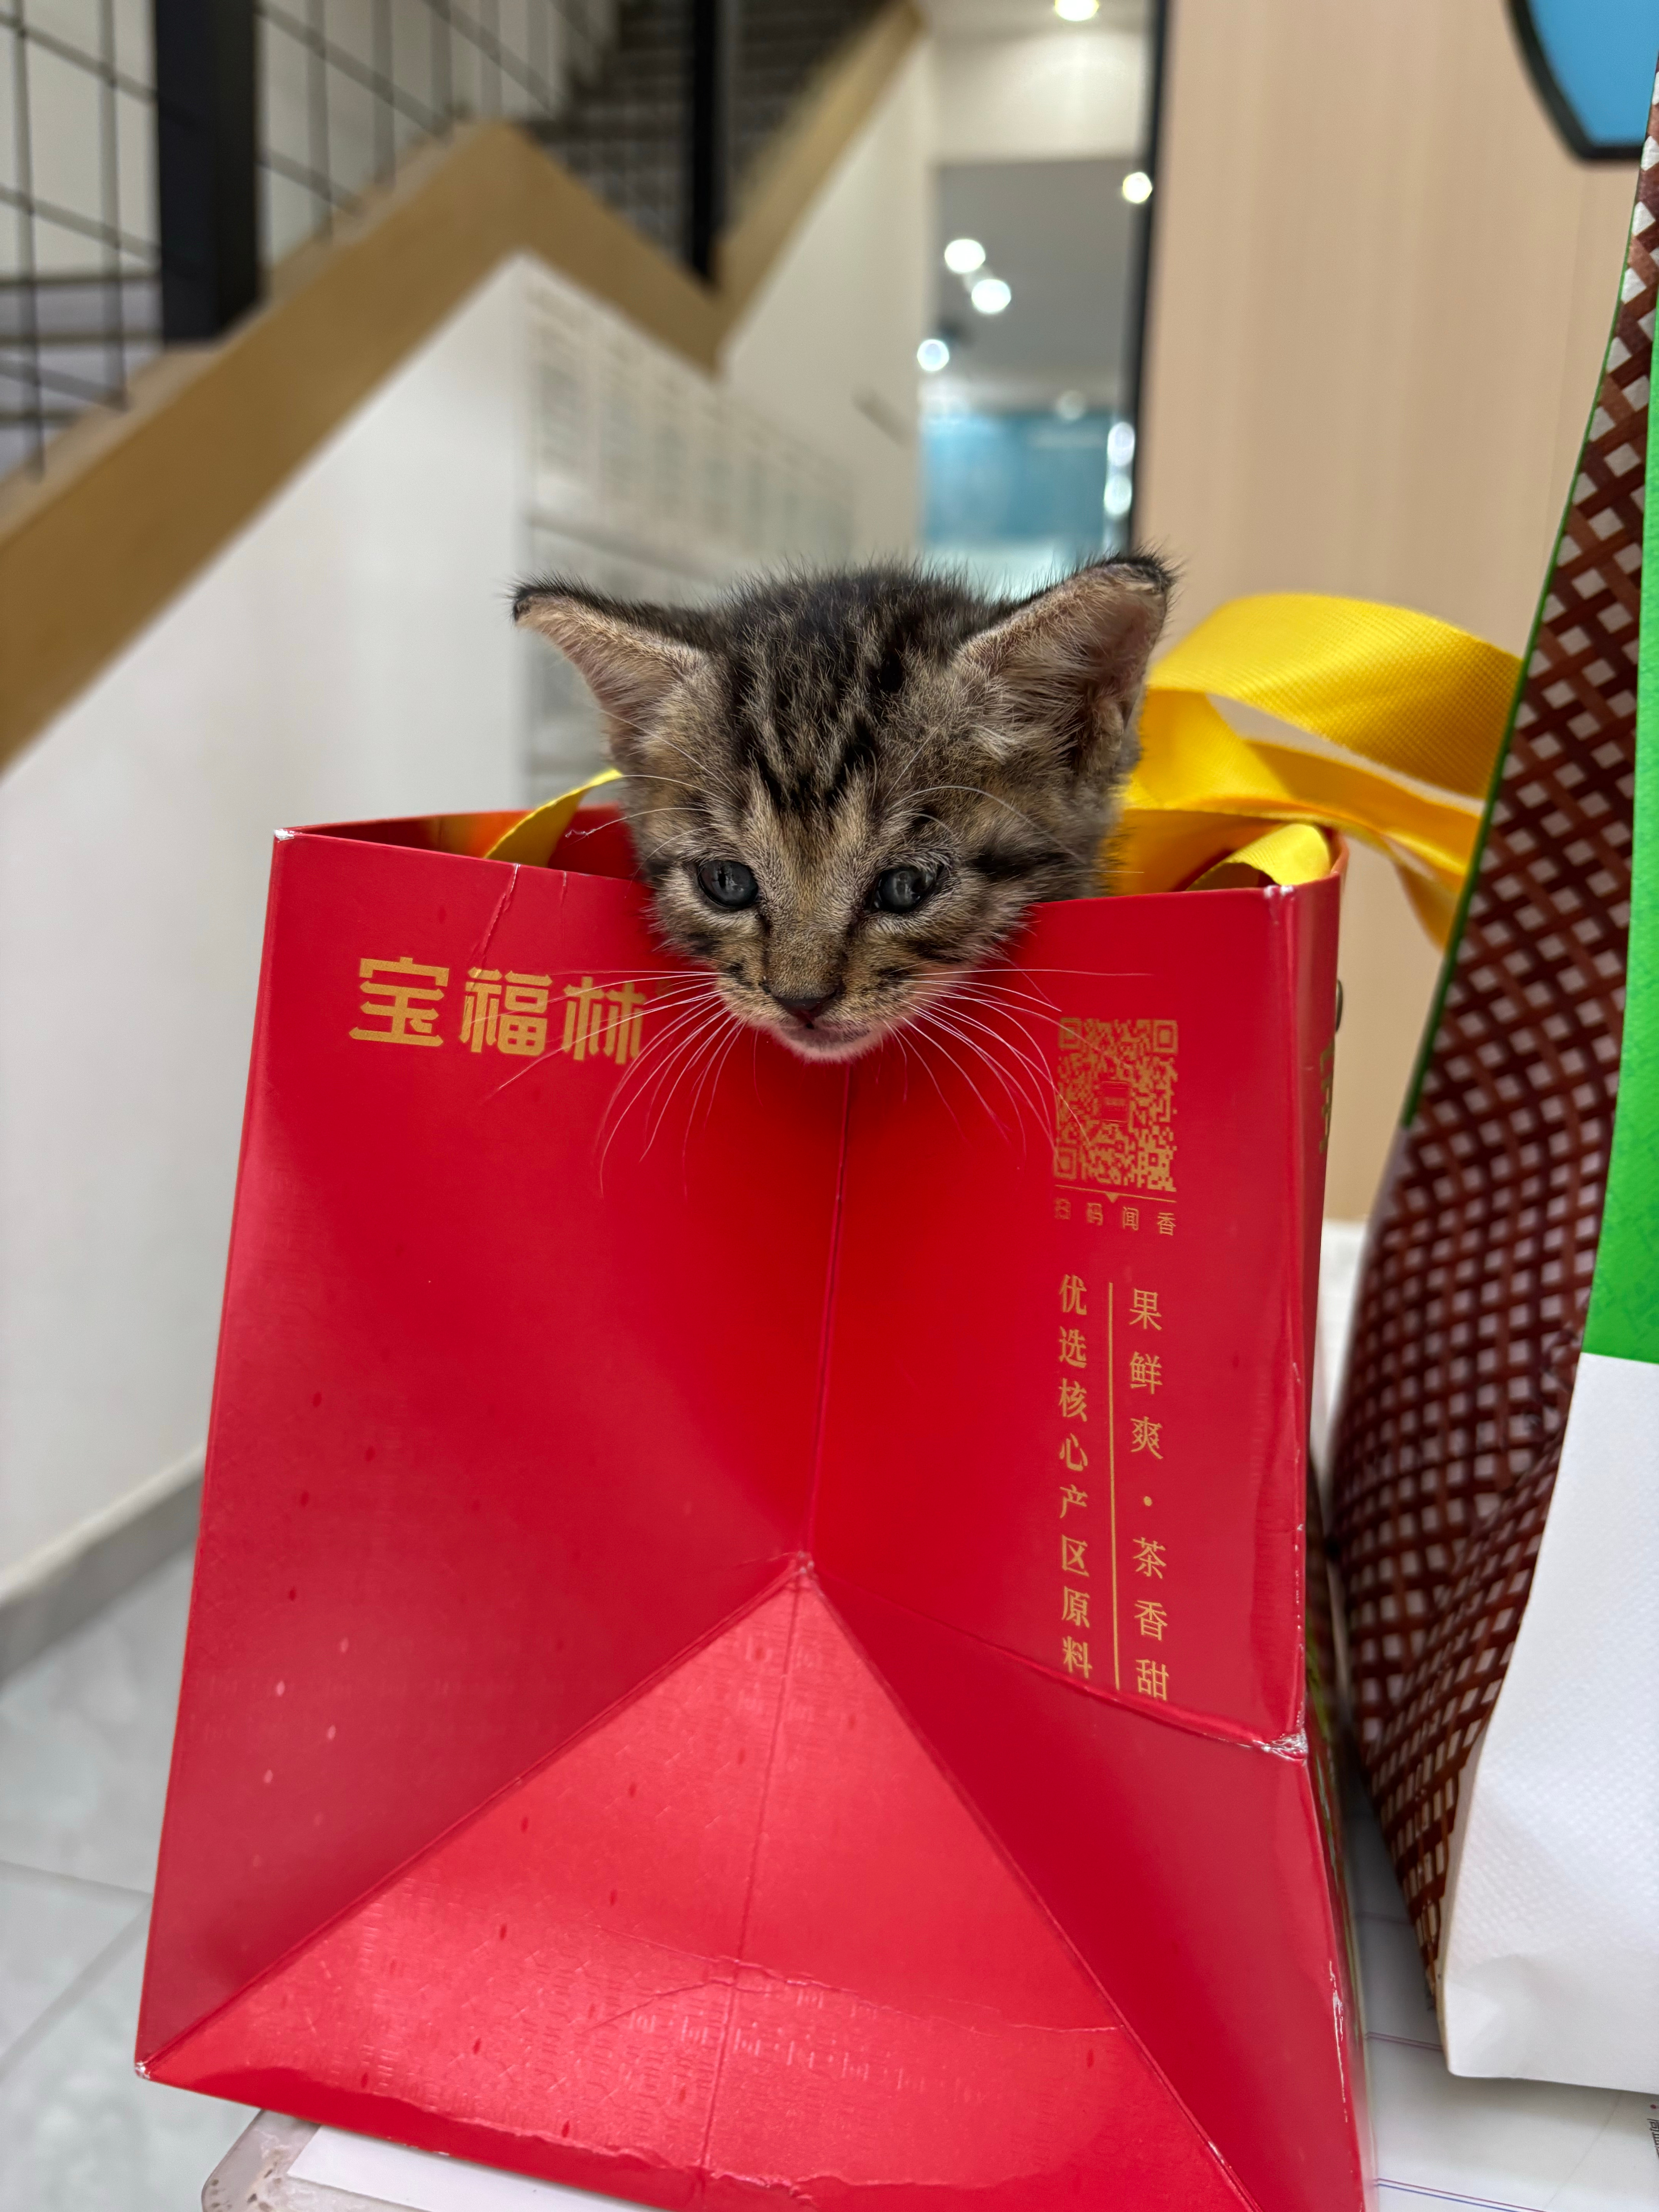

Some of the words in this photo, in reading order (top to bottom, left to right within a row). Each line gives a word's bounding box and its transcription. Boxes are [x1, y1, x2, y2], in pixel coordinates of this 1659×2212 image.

[349, 956, 647, 1065] 宝福林
[1058, 1274, 1092, 1679] 优选核心产区原料
